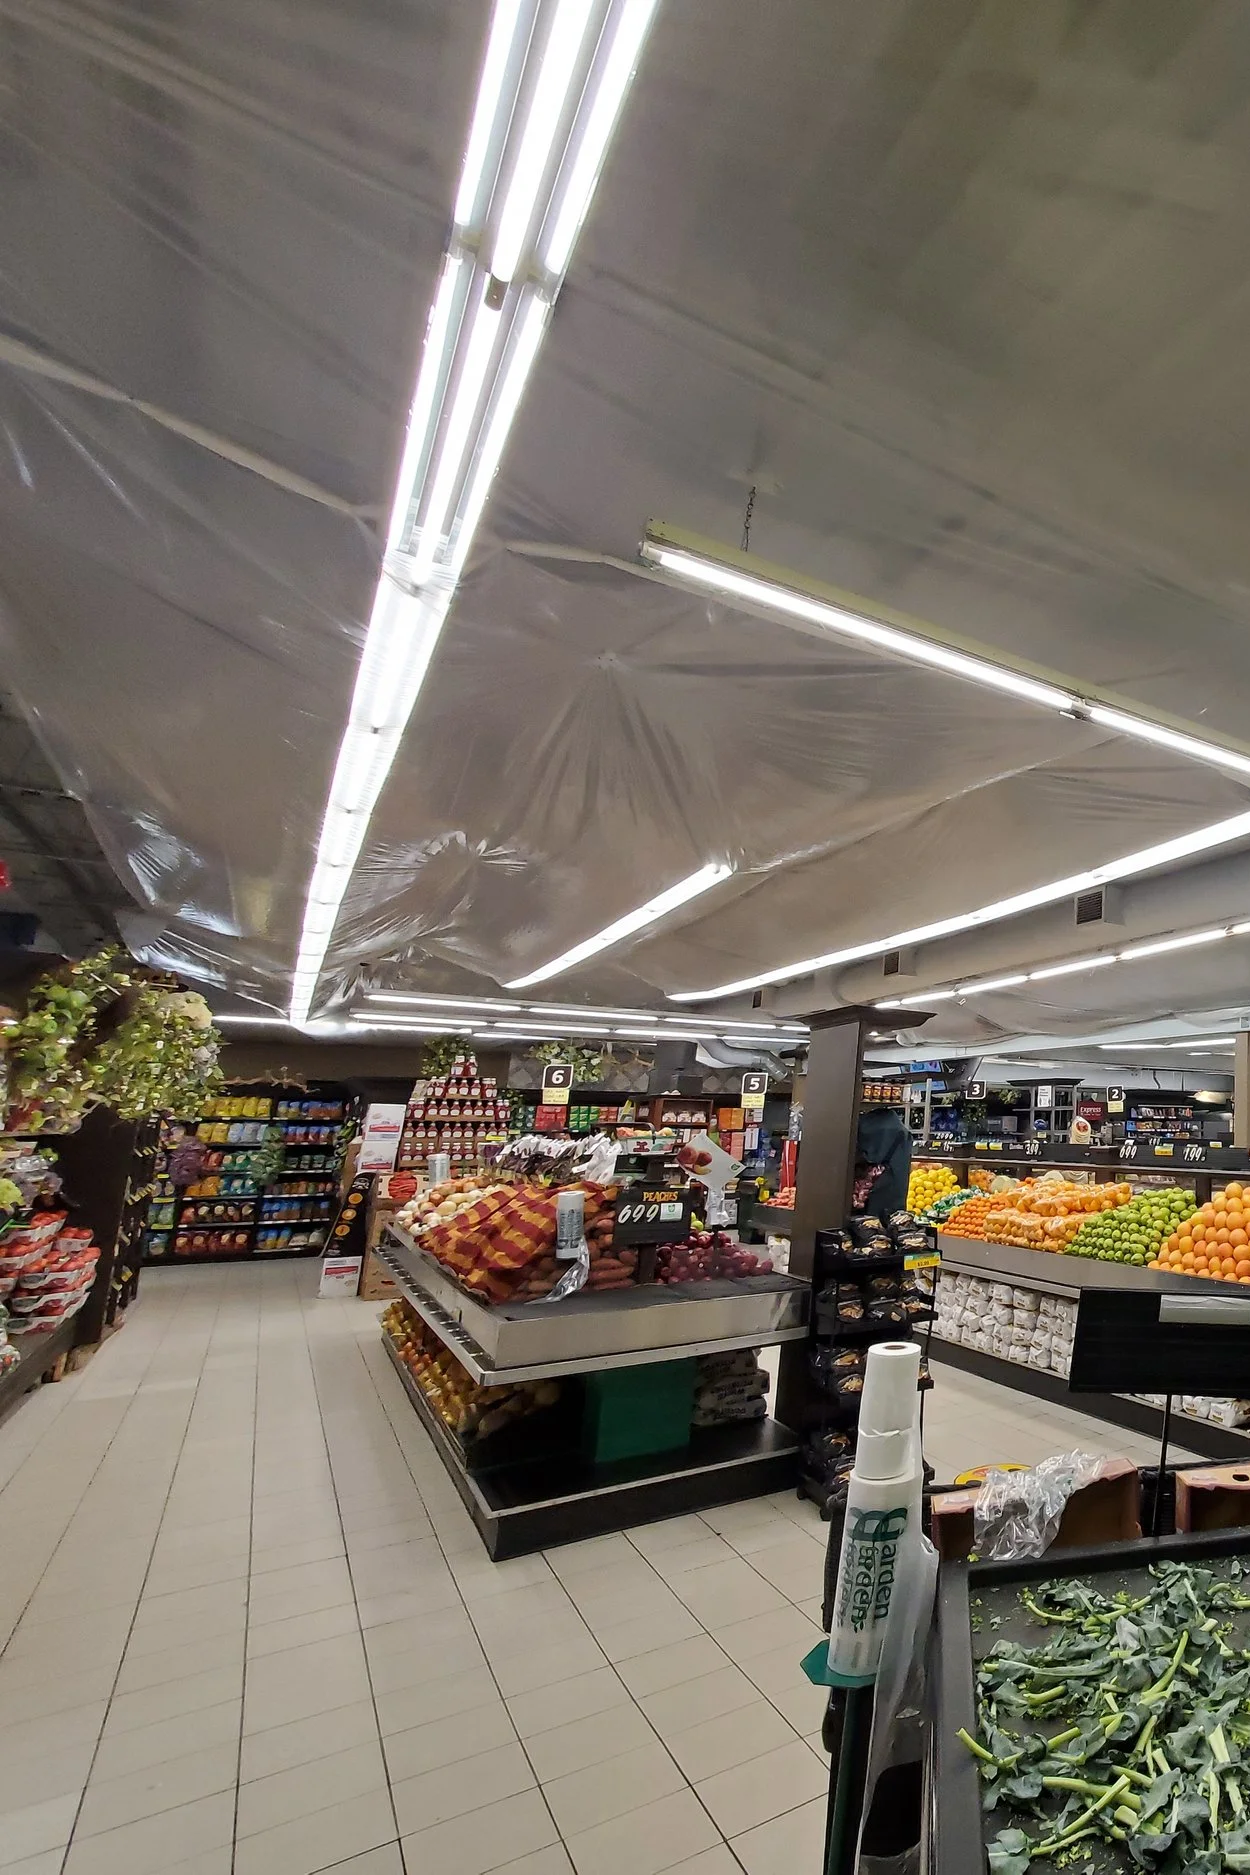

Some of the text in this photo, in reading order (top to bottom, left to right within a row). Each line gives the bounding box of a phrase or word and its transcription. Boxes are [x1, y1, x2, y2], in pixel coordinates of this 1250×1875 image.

[552, 1070, 565, 1085] 6
[749, 1076, 760, 1090] 5
[972, 1084, 980, 1095] 3
[1111, 1088, 1119, 1099] 2
[643, 1191, 679, 1202] PEACHES
[873, 1507, 908, 1619] Garden
